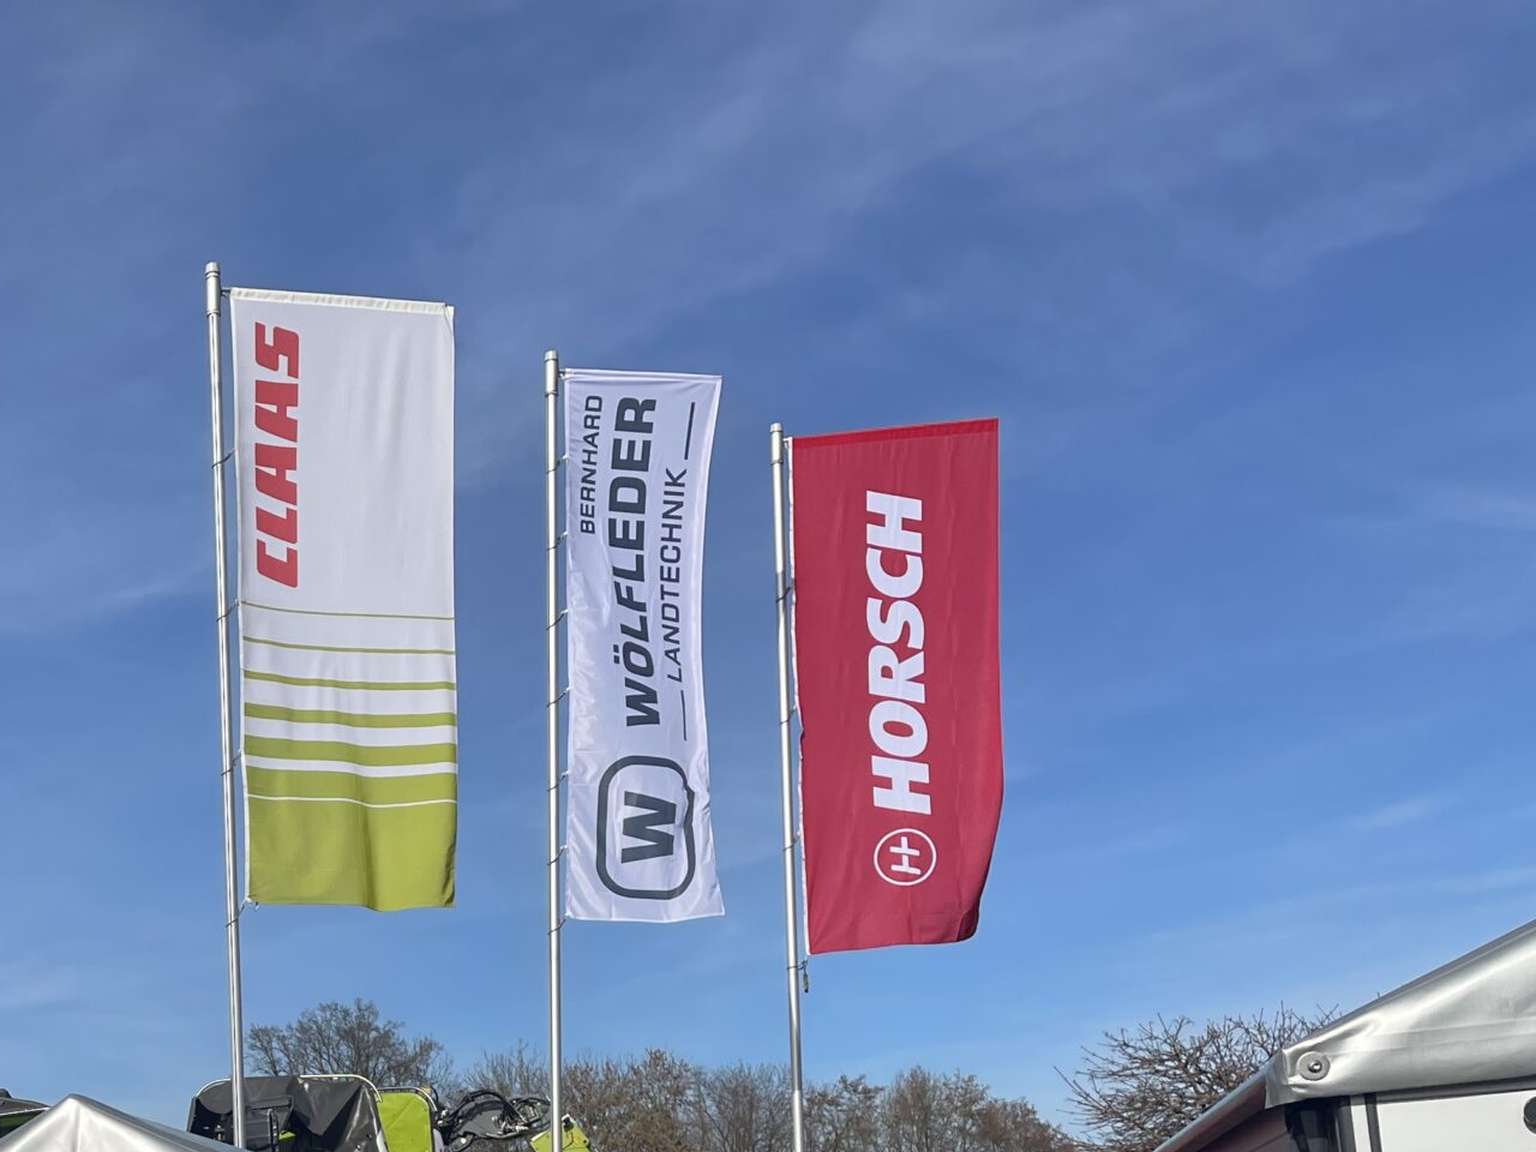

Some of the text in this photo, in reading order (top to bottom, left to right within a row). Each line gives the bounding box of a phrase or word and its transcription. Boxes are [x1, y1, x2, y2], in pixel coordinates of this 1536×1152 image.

[255, 321, 299, 588] CLAAS
[580, 395, 602, 534] BERNHARD
[608, 396, 660, 727] WÖLFLEDER
[659, 467, 688, 683] LANDTECHNIK
[866, 490, 931, 815] HORSCH
[621, 790, 677, 864] W
